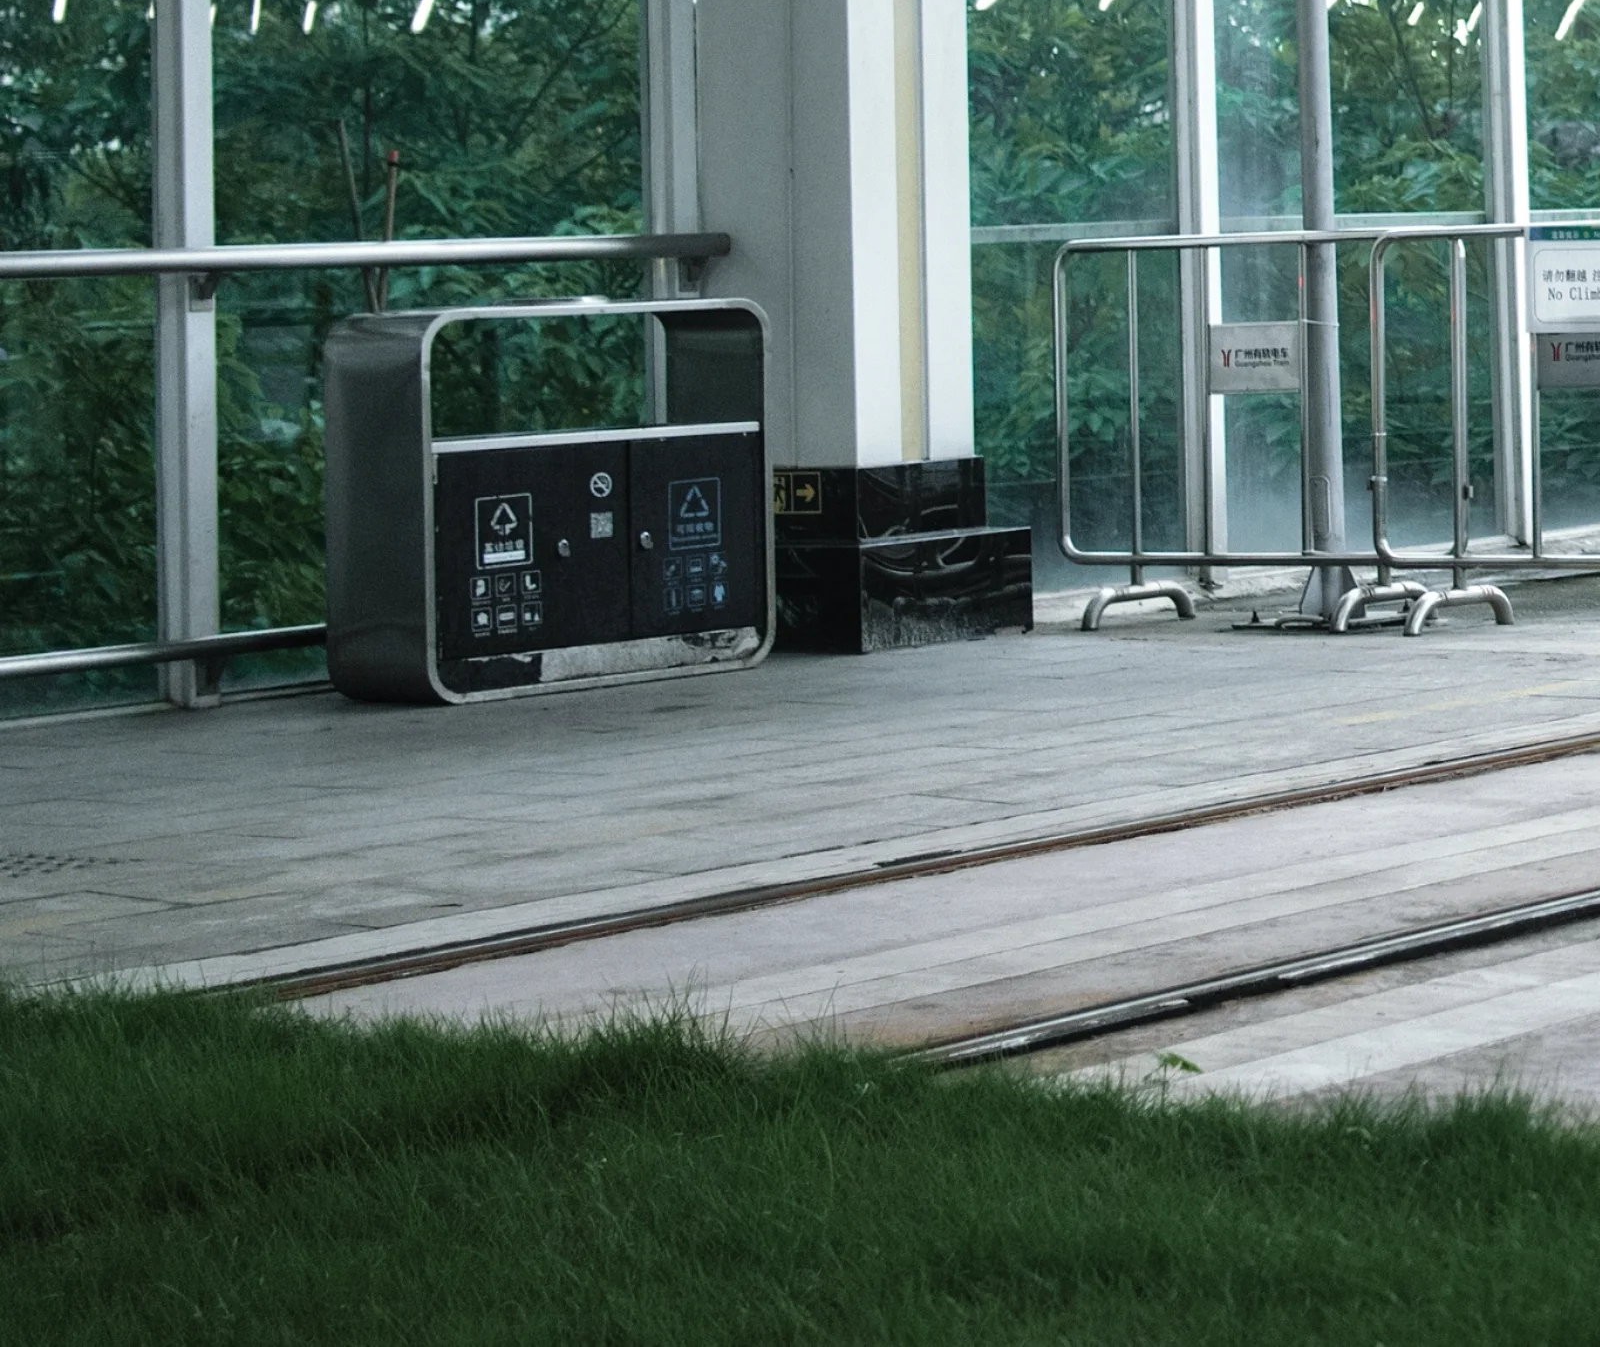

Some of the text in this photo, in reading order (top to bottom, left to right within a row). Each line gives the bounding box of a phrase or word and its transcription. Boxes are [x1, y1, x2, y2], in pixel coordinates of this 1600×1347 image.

[1542, 269, 1587, 282] 请勿翻越
[1548, 287, 1563, 301] No
[1234, 347, 1289, 359] 广州有轨电车
